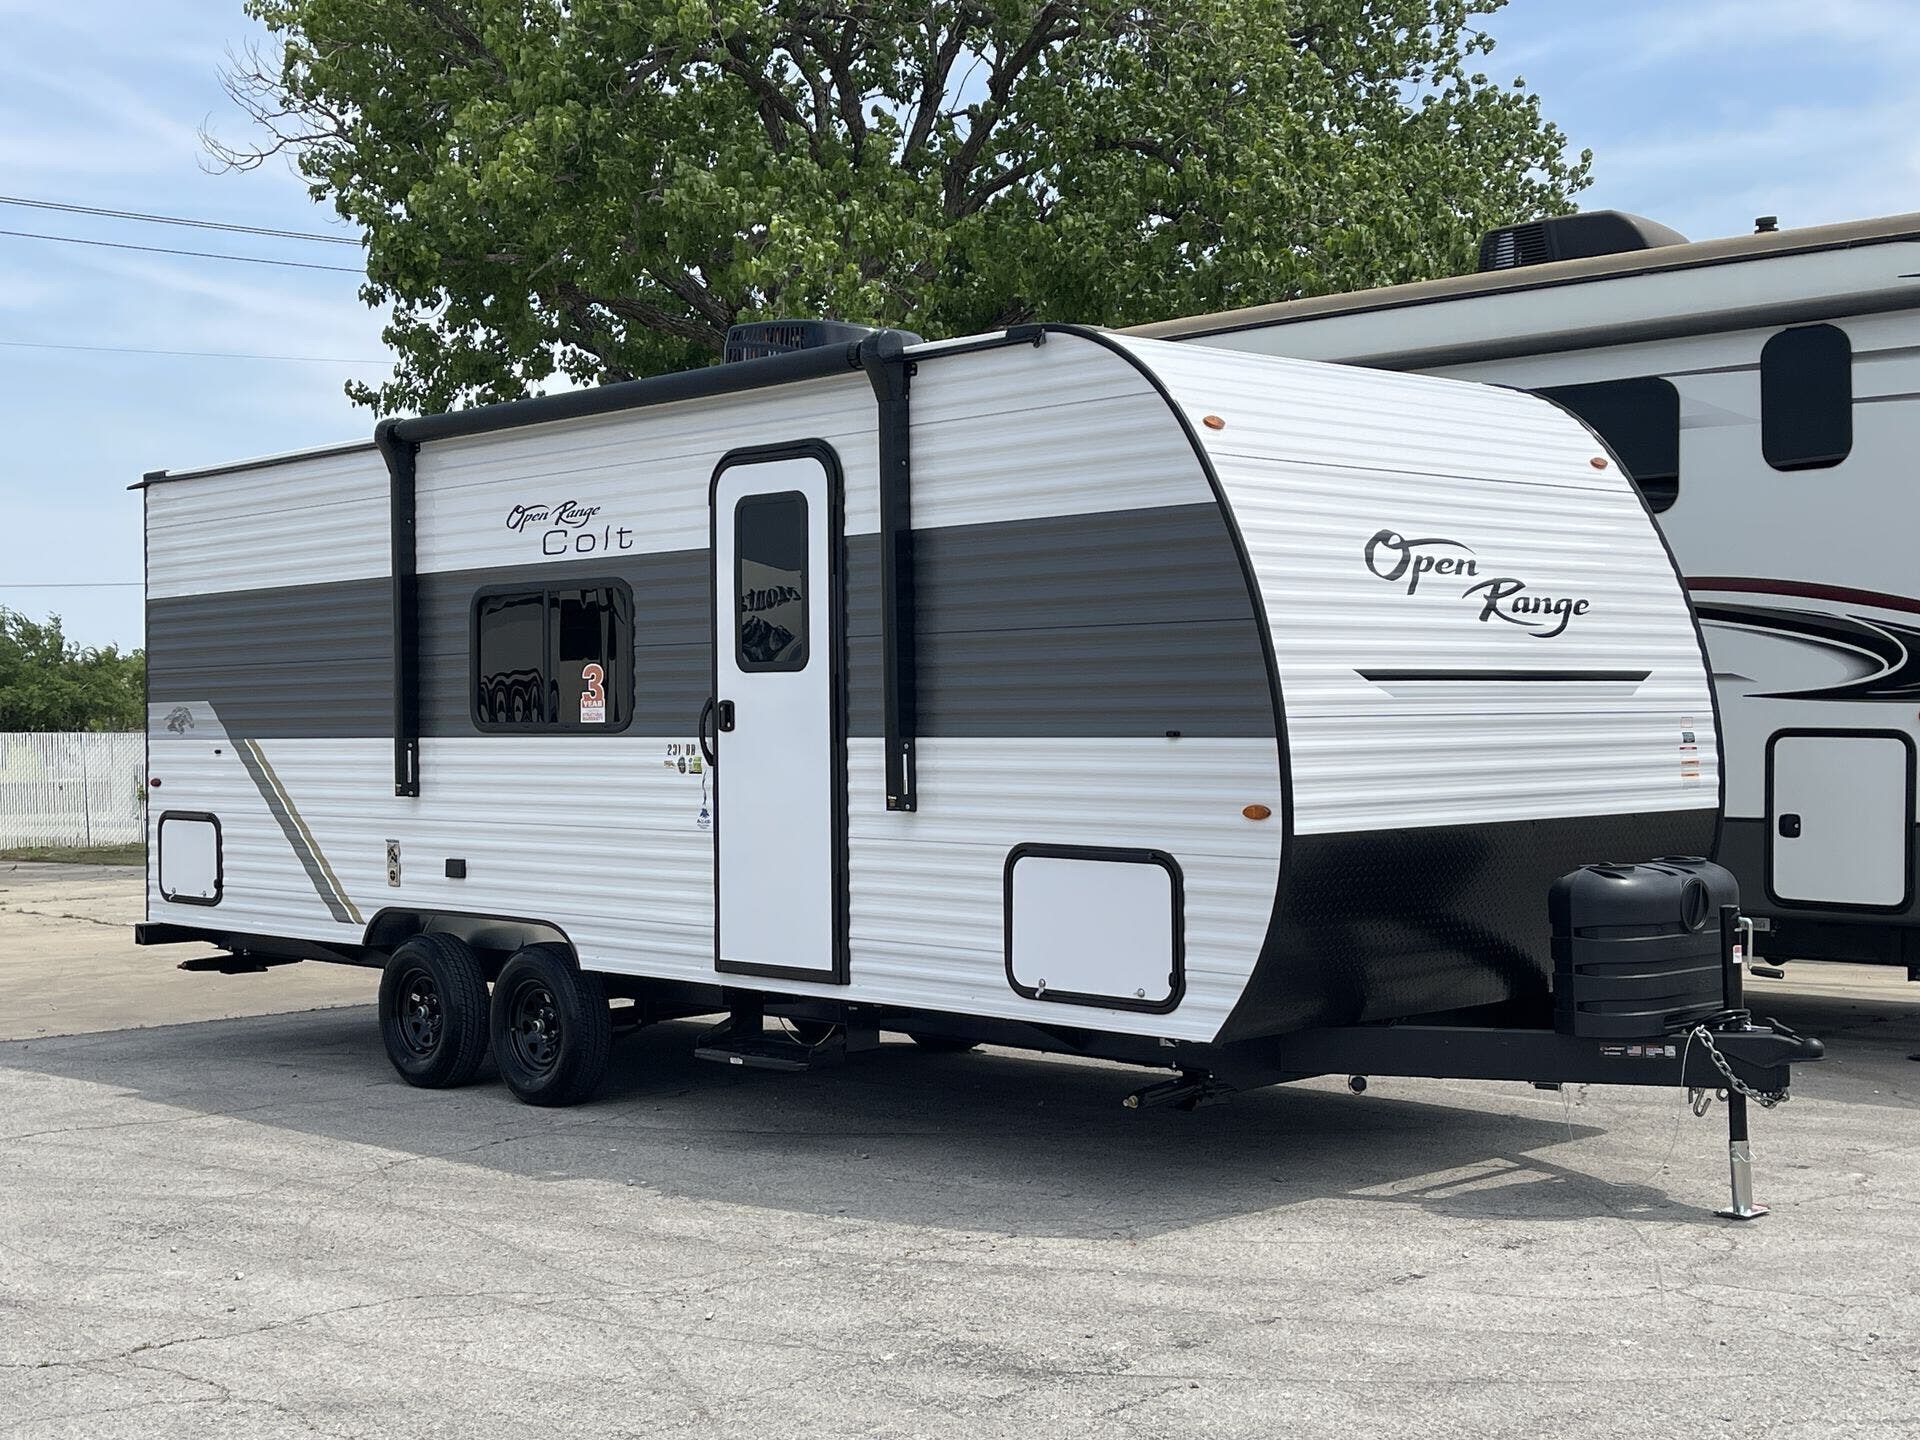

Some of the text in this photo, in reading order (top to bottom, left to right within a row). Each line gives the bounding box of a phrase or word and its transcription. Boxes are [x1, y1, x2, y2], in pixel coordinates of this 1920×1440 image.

[506, 500, 601, 533] Open Range
[543, 525, 633, 555] Colt
[1364, 529, 1479, 595] Open
[1462, 577, 1591, 638] Range
[582, 663, 605, 702] 3
